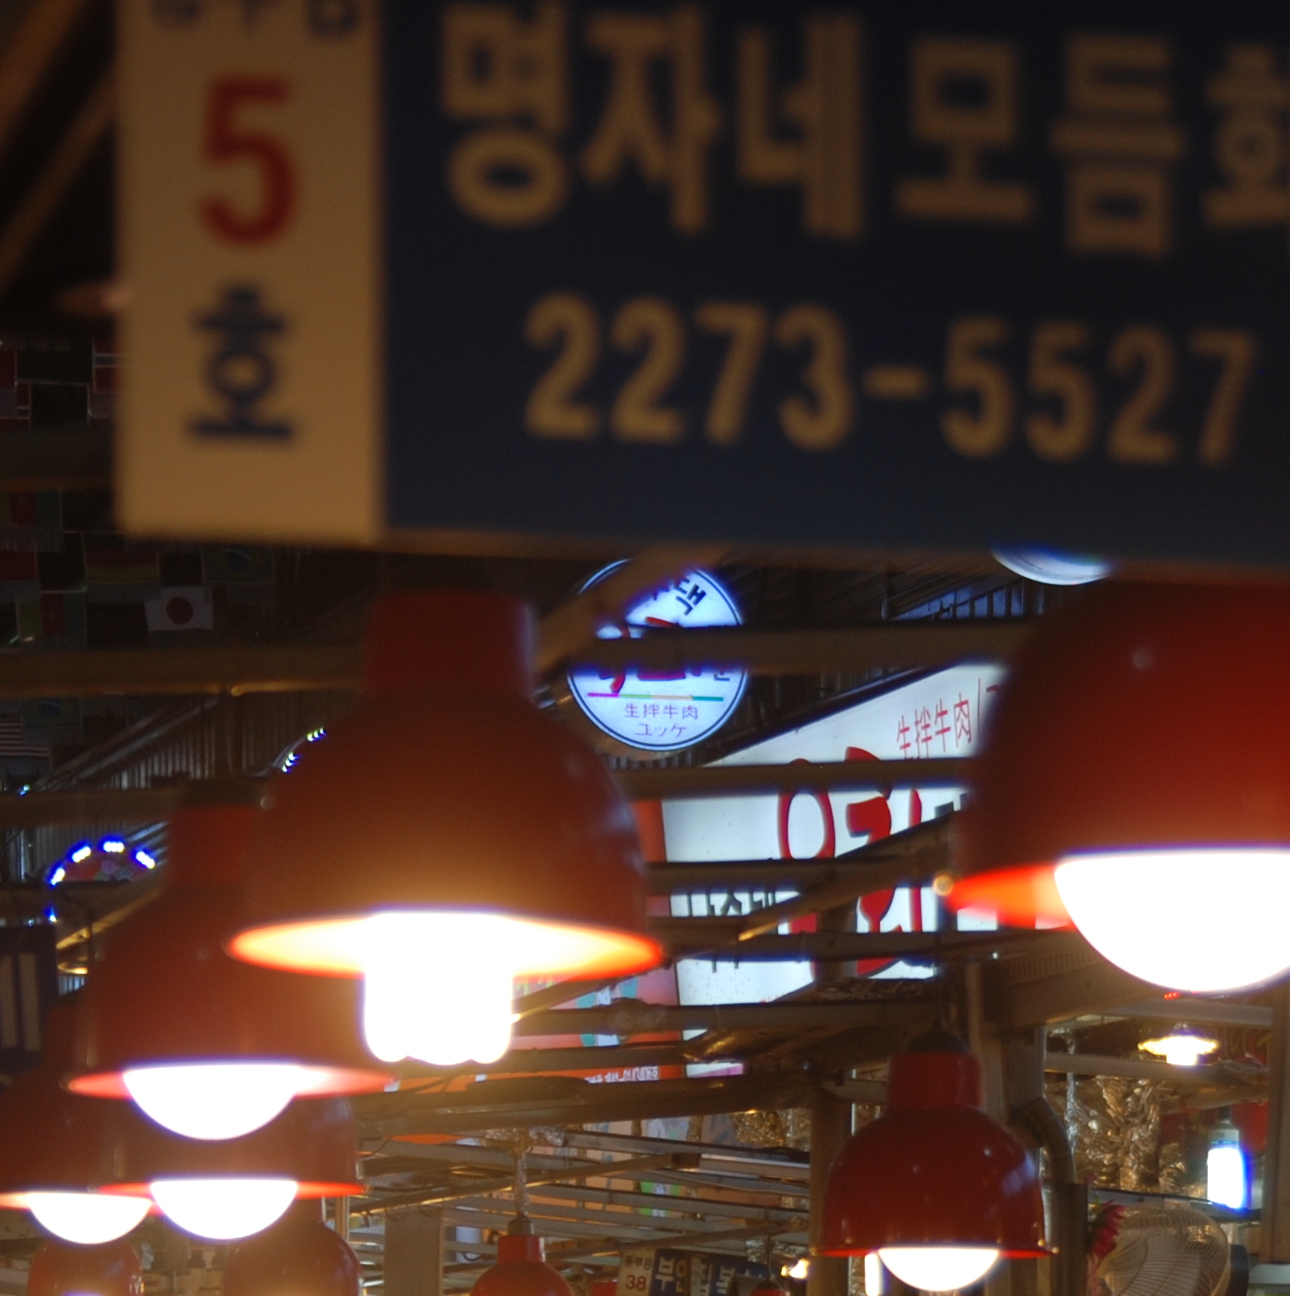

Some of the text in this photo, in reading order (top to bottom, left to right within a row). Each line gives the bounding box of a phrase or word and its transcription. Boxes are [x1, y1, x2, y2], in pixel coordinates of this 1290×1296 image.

[198, 76, 297, 244] 5
[437, 2, 866, 242] 명자네
[187, 284, 296, 443] 호
[524, 292, 1259, 468] 2273-5527
[625, 1273, 647, 1291] 38
